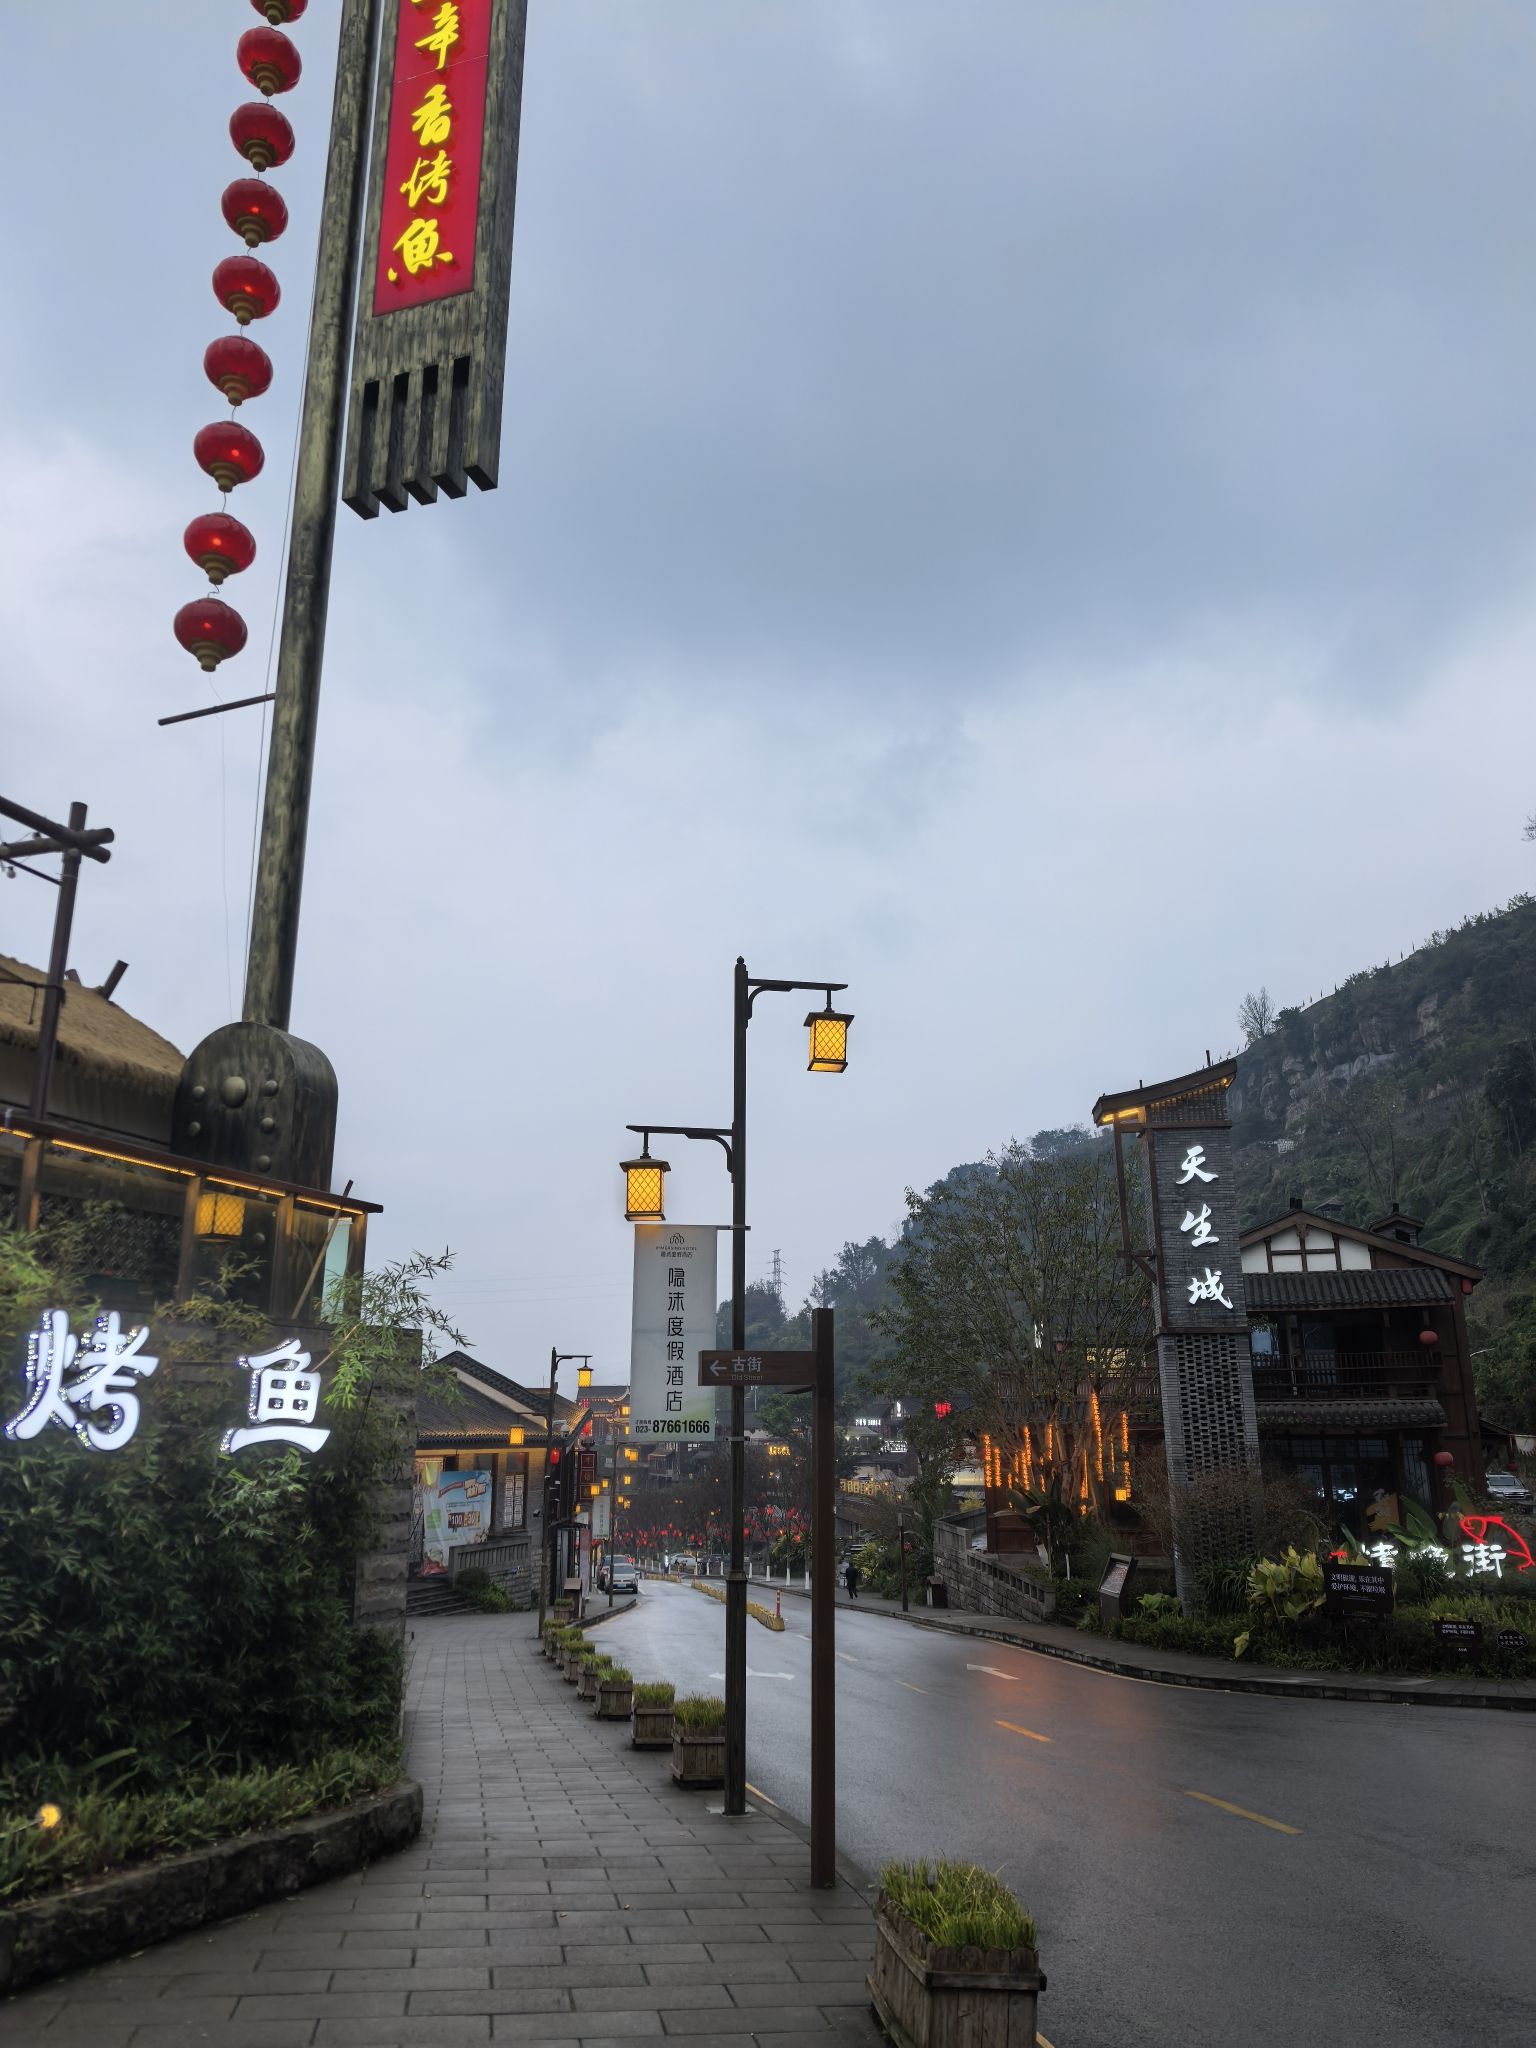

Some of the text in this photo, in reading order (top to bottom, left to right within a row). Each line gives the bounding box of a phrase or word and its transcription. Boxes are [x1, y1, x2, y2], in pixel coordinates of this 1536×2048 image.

[1175, 1145, 1234, 1310] 天生城
[5, 1308, 331, 1454] 烤鱼
[665, 1267, 685, 1412] 隐沫度假酒店
[731, 1355, 762, 1373] 古街
